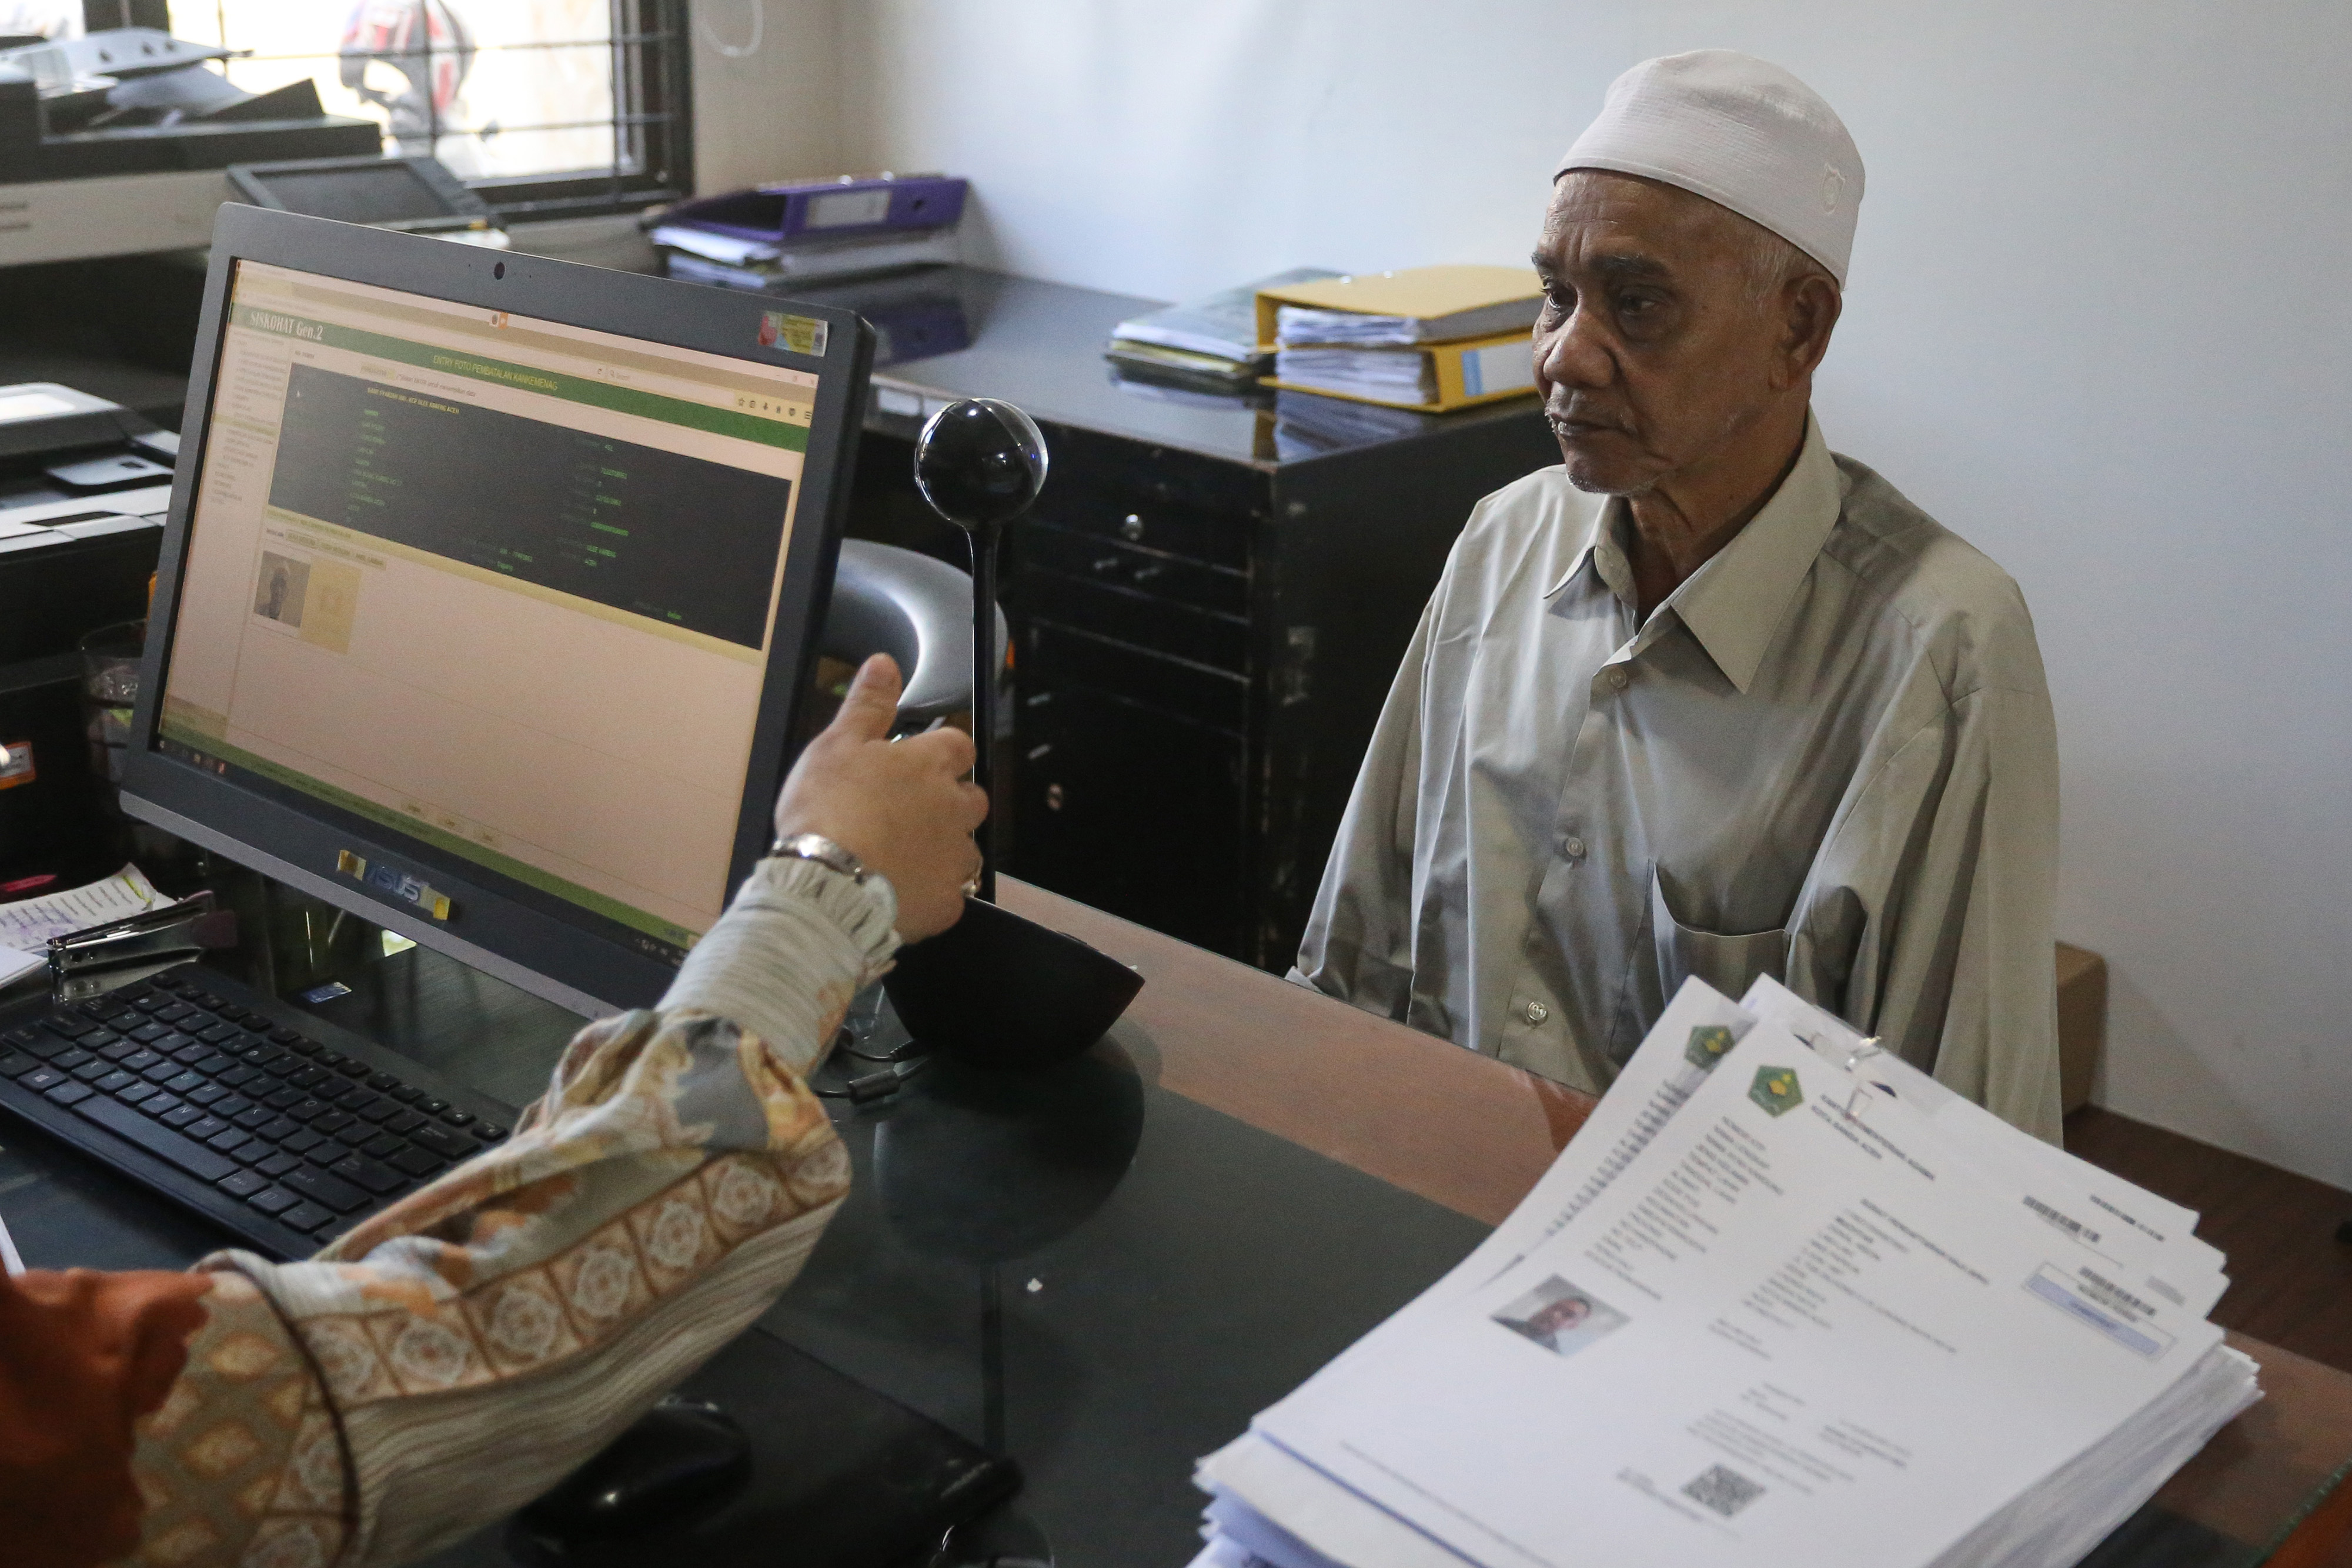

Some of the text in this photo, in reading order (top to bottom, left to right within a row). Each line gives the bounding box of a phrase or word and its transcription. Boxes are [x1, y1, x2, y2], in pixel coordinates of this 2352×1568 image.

[250, 311, 323, 341] SISKOHAT Gen.2
[433, 355, 558, 390] ENTRY FOTO PEMBATALAN KANKEMENAG
